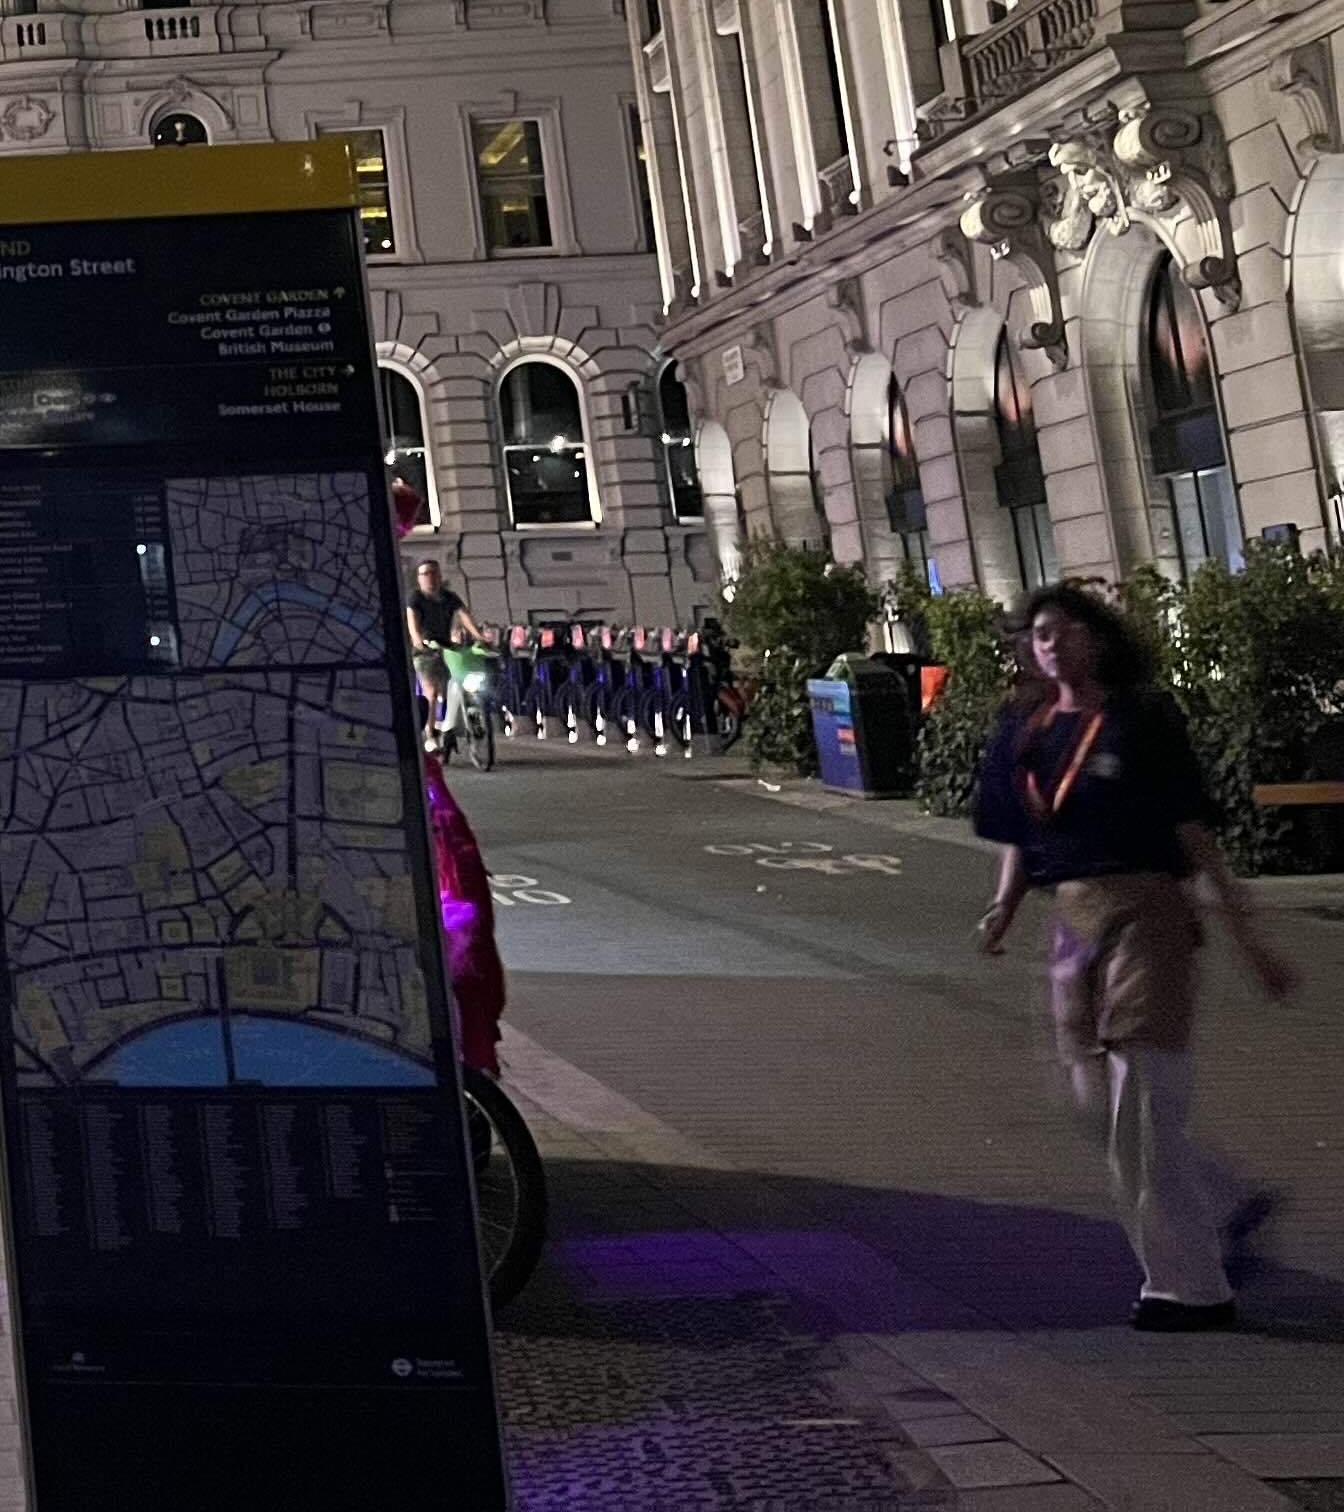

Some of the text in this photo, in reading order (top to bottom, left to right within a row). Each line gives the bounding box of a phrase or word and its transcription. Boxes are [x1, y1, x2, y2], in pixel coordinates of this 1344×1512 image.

[70, 258, 136, 276] Street
[168, 311, 221, 325] Covent
[226, 308, 280, 322] Garden
[200, 323, 313, 340] Covent Garden
[218, 340, 334, 356] British Museum
[218, 399, 341, 416] Somerset House
